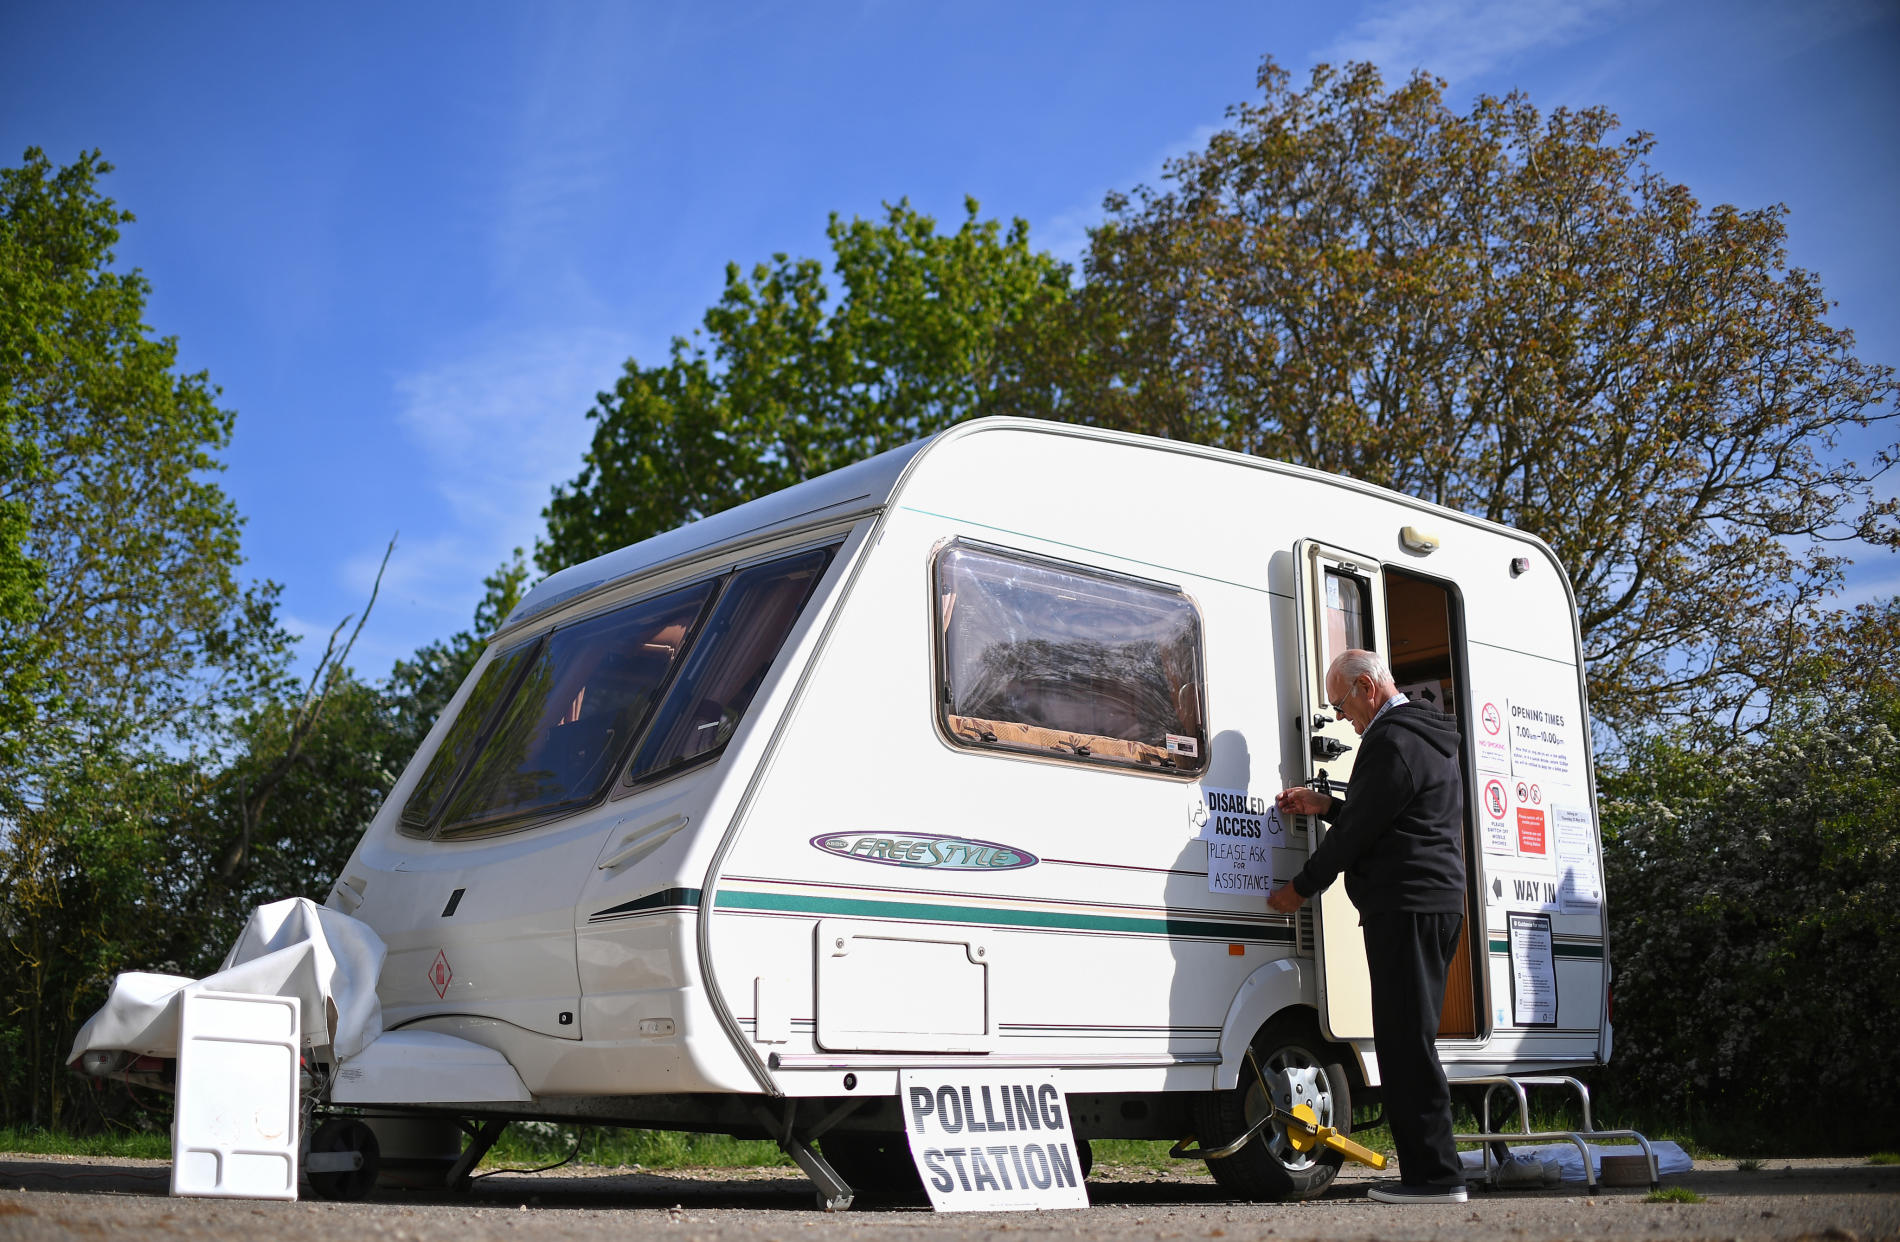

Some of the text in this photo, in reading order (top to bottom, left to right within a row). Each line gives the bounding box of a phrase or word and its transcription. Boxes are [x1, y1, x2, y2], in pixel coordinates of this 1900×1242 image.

[1511, 705, 1565, 727] OPENING TIMES
[1208, 792, 1265, 816] DISABLED
[1215, 816, 1262, 839] ACCESS
[1210, 842, 1267, 863] PLEASE ASK
[1233, 861, 1245, 870] FOR
[1214, 872, 1270, 890] ASSISTANCE
[1513, 880, 1539, 902] WAY
[1543, 882, 1556, 904] IN
[909, 1083, 1065, 1135] POLLING
[923, 1143, 1077, 1194] STATION
